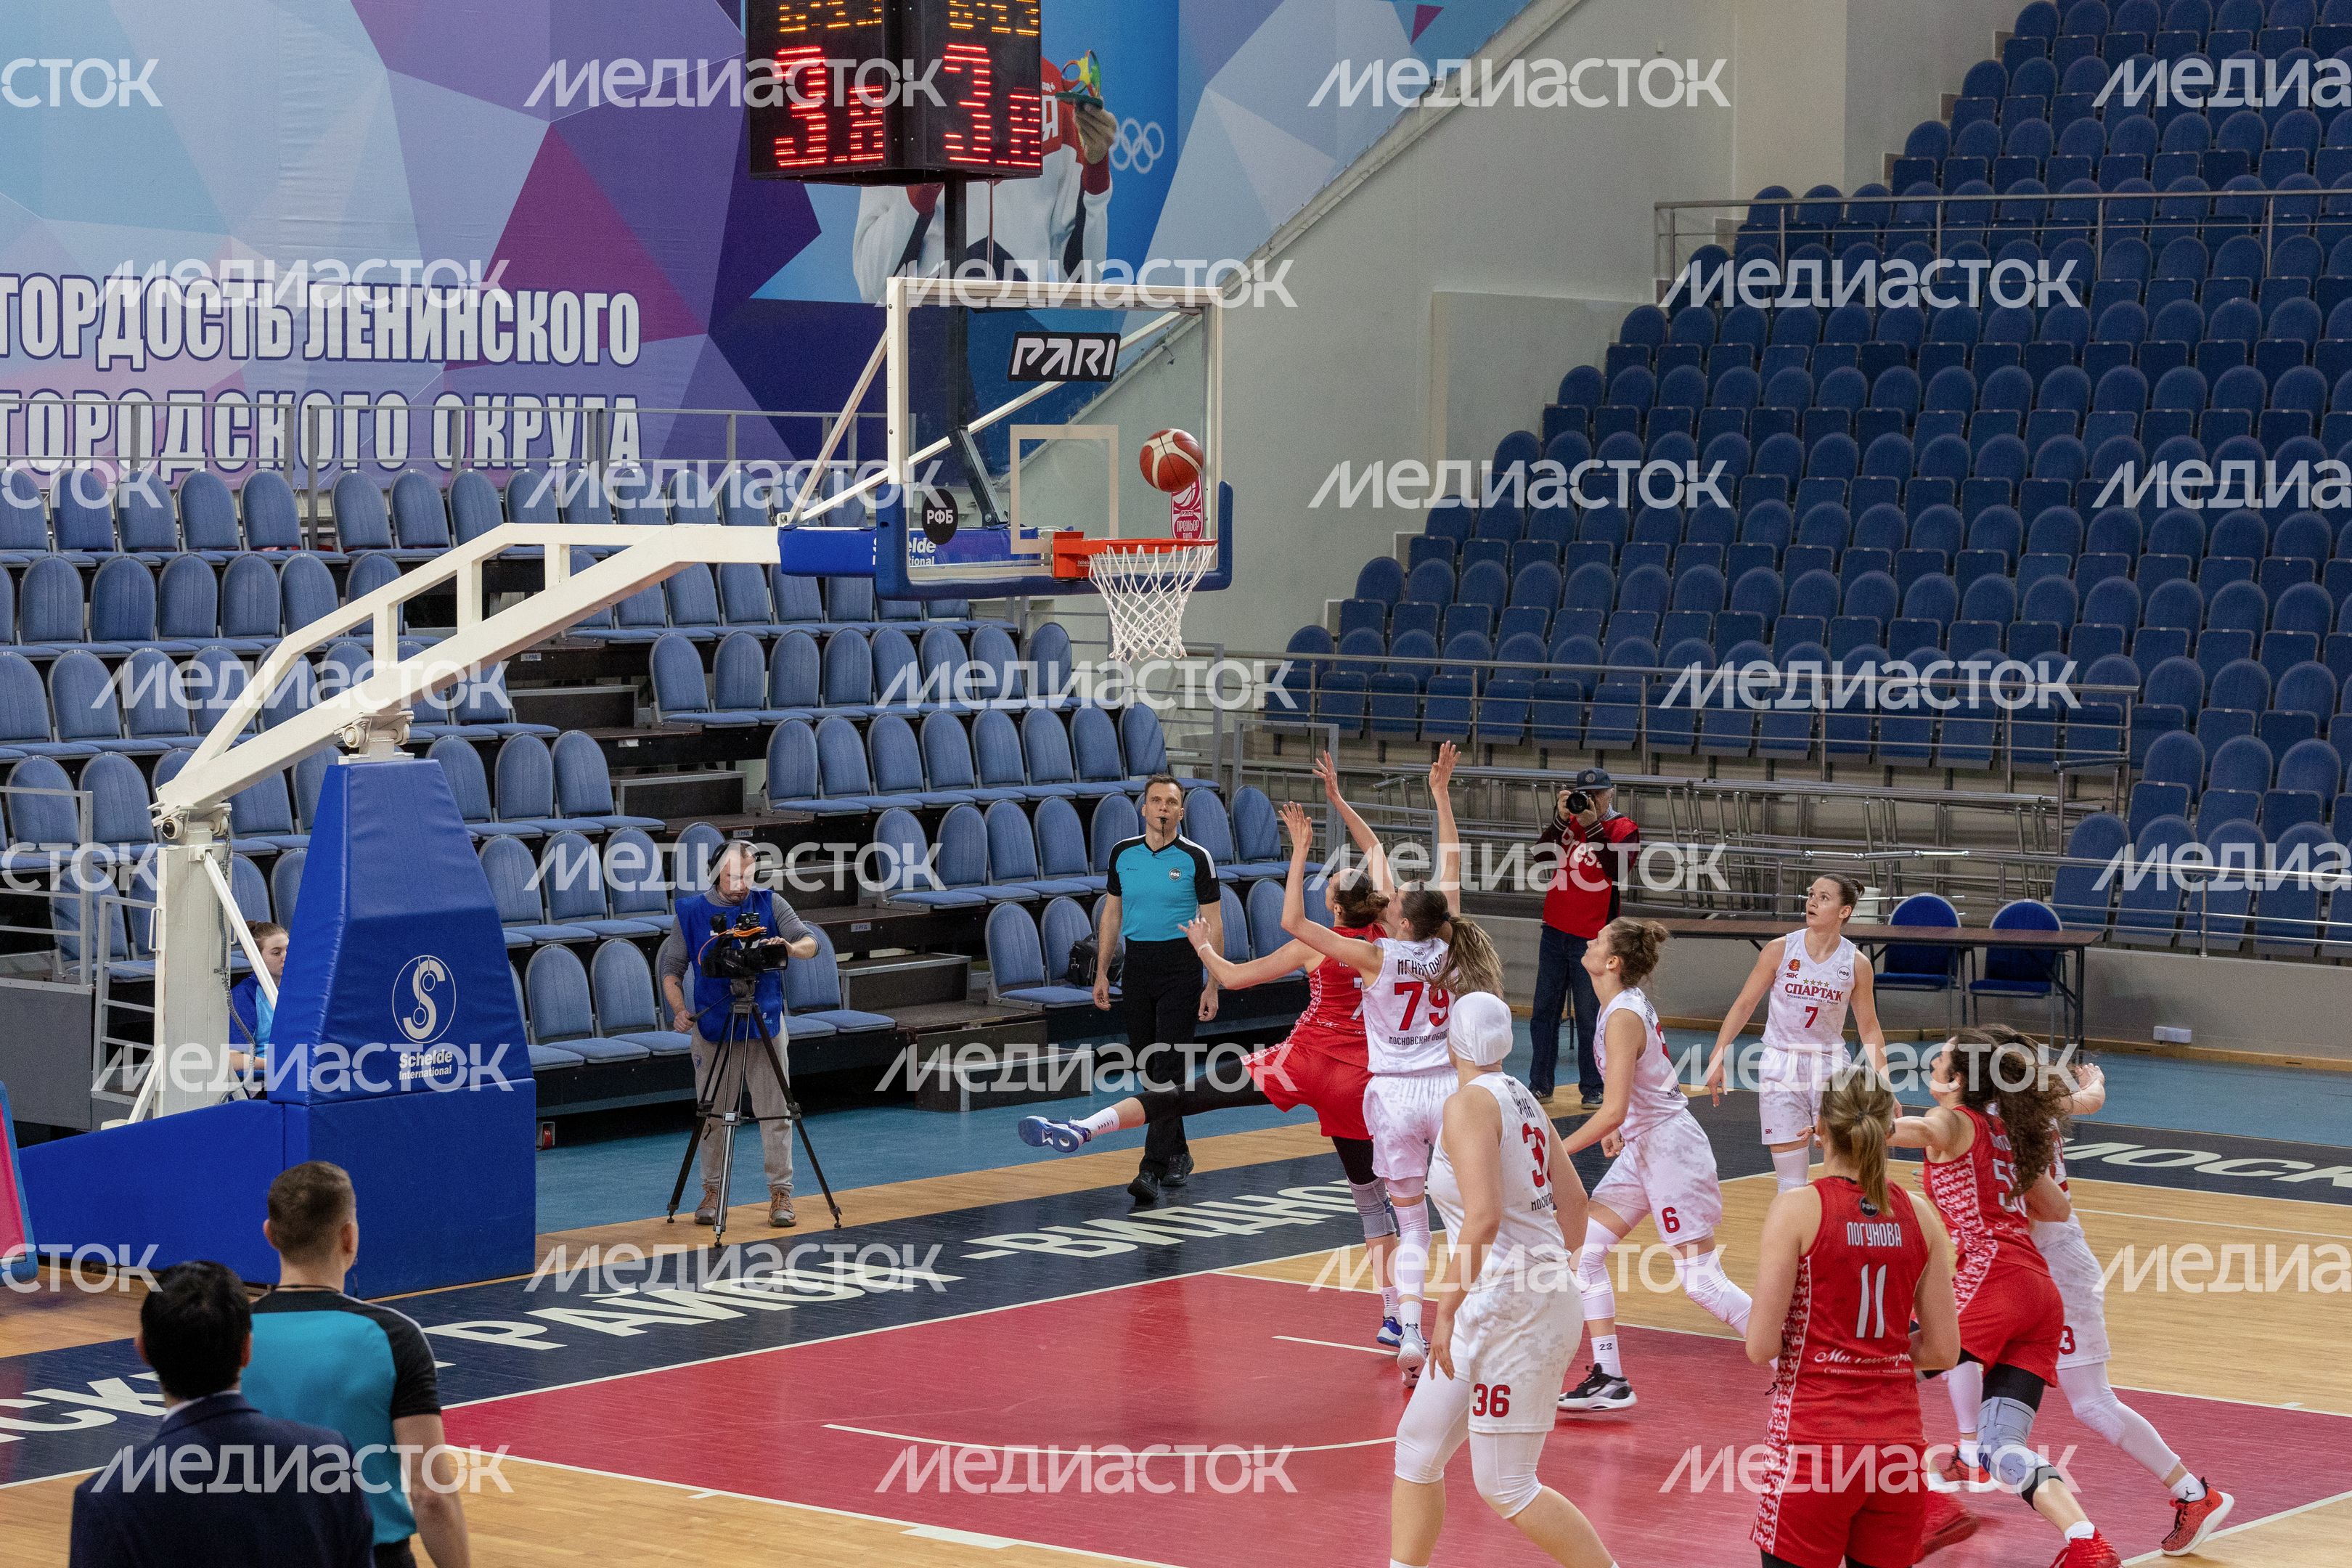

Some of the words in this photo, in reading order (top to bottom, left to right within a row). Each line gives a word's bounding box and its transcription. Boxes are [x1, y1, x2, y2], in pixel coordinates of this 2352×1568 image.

[0, 272, 293, 372] ГОРДОСТЬ
[302, 280, 642, 367] ЛЕНИНСКОГО
[1012, 337, 1118, 377] PARI
[926, 509, 954, 524] РФБ
[1177, 520, 1199, 532] ПРЕМЬЕР
[1785, 983, 1843, 1002] СПАРТАК
[1395, 981, 1450, 1031] 79
[1805, 1006, 1818, 1028] 7
[399, 1049, 453, 1069] Schelde
[399, 1065, 452, 1080] International
[1662, 1206, 1680, 1233] 6
[1846, 1221, 1903, 1247] ПОГУНОВА
[1855, 1263, 1887, 1339] 11
[1472, 1383, 1511, 1418] 36
